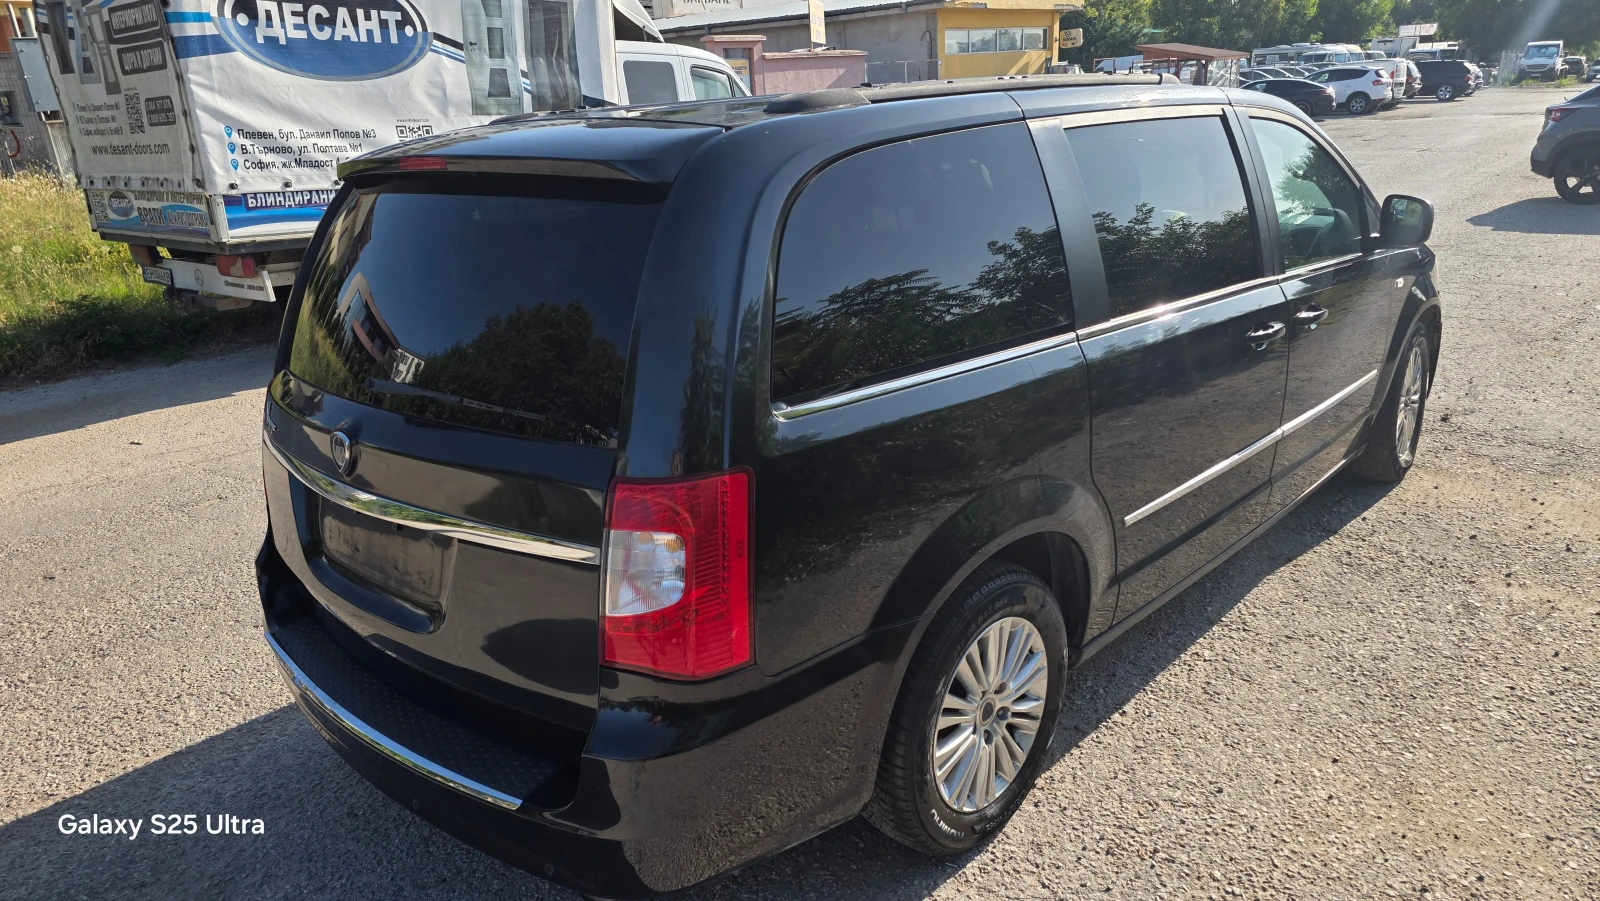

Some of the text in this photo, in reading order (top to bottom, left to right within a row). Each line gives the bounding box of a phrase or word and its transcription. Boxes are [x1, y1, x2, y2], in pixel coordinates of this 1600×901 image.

[255, 1, 402, 45] ДЕСАНТ
[237, 129, 376, 142] Плевен, бул. Данаил Попов №3
[91, 141, 170, 155] www.desant-doors.com
[241, 143, 363, 157] В.Търново, ул. Полтава №1
[243, 159, 279, 172] София,
[281, 158, 333, 169] жк.Младост
[137, 207, 165, 225] ВРАТИ
